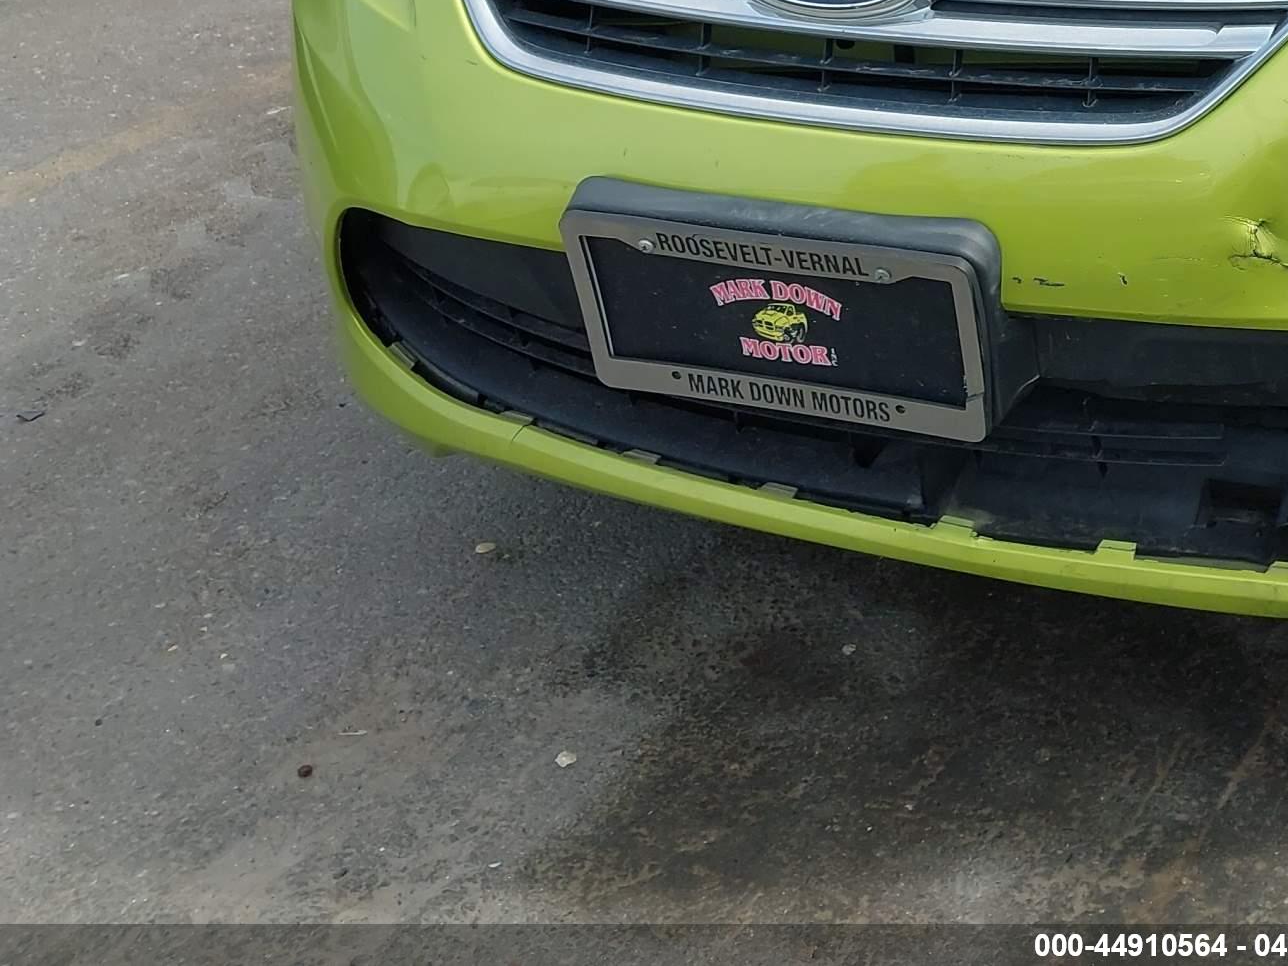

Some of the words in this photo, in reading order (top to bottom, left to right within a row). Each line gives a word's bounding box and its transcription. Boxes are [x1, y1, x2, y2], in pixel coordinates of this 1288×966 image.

[656, 232, 870, 277] ROOSEVELT-VERNAL
[709, 278, 771, 307] MARK
[769, 279, 842, 321] DOWN
[739, 336, 832, 366] MOTOR
[688, 373, 745, 400] MARK
[749, 382, 806, 409] DOWN
[811, 390, 891, 423] MOTORS
